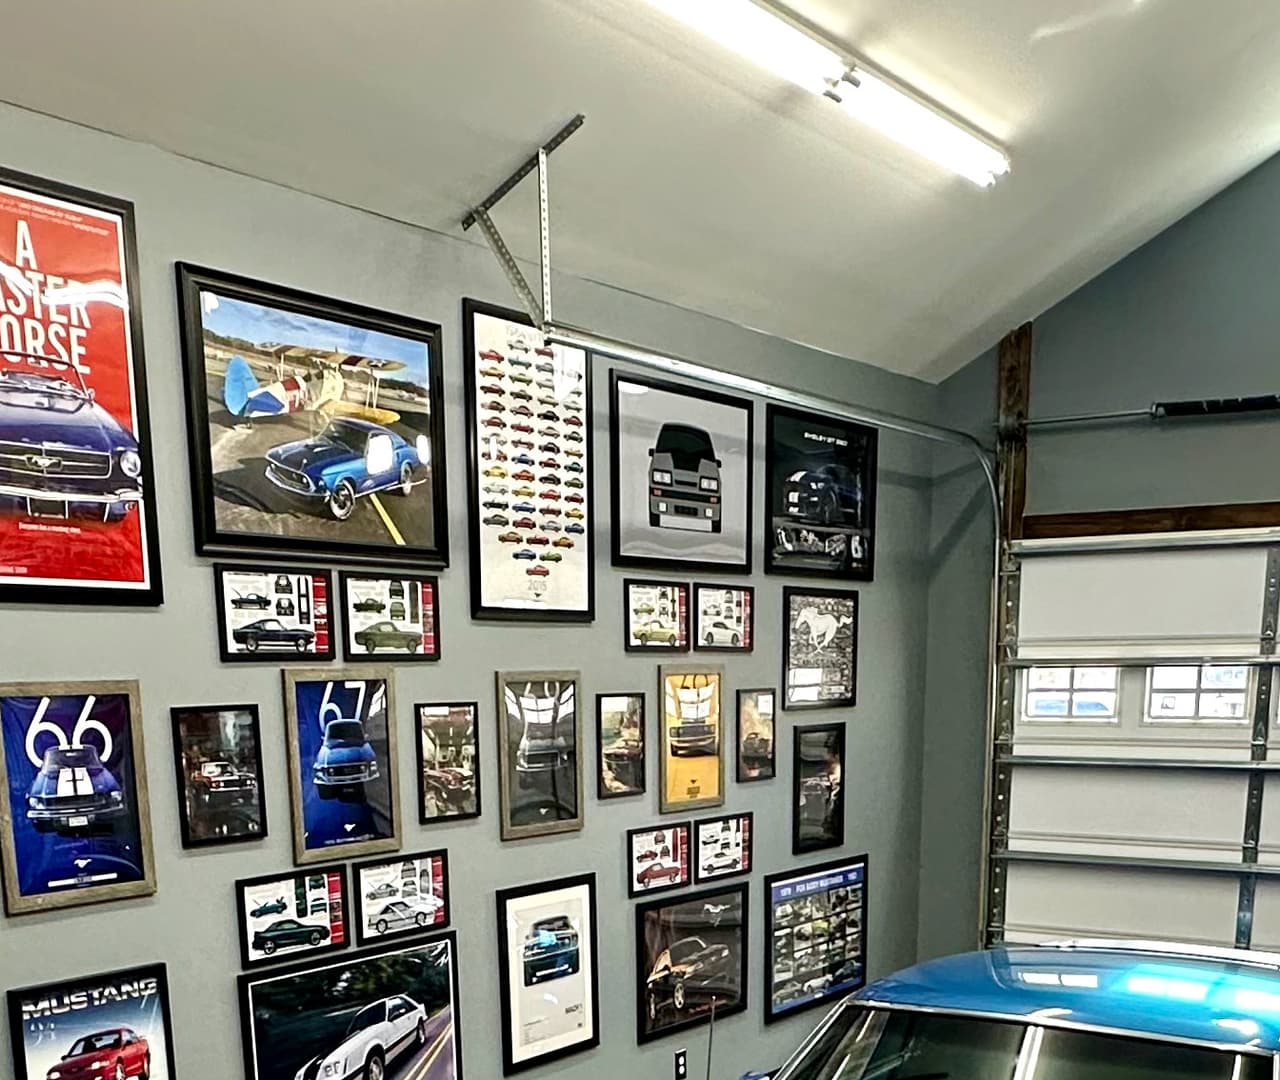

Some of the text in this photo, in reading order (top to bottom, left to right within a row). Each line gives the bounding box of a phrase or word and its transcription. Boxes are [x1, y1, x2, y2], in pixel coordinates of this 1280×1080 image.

[15, 219, 38, 270] A
[25, 695, 114, 768] 66
[319, 681, 366, 733] 67
[21, 977, 158, 1020] MUSTANG
